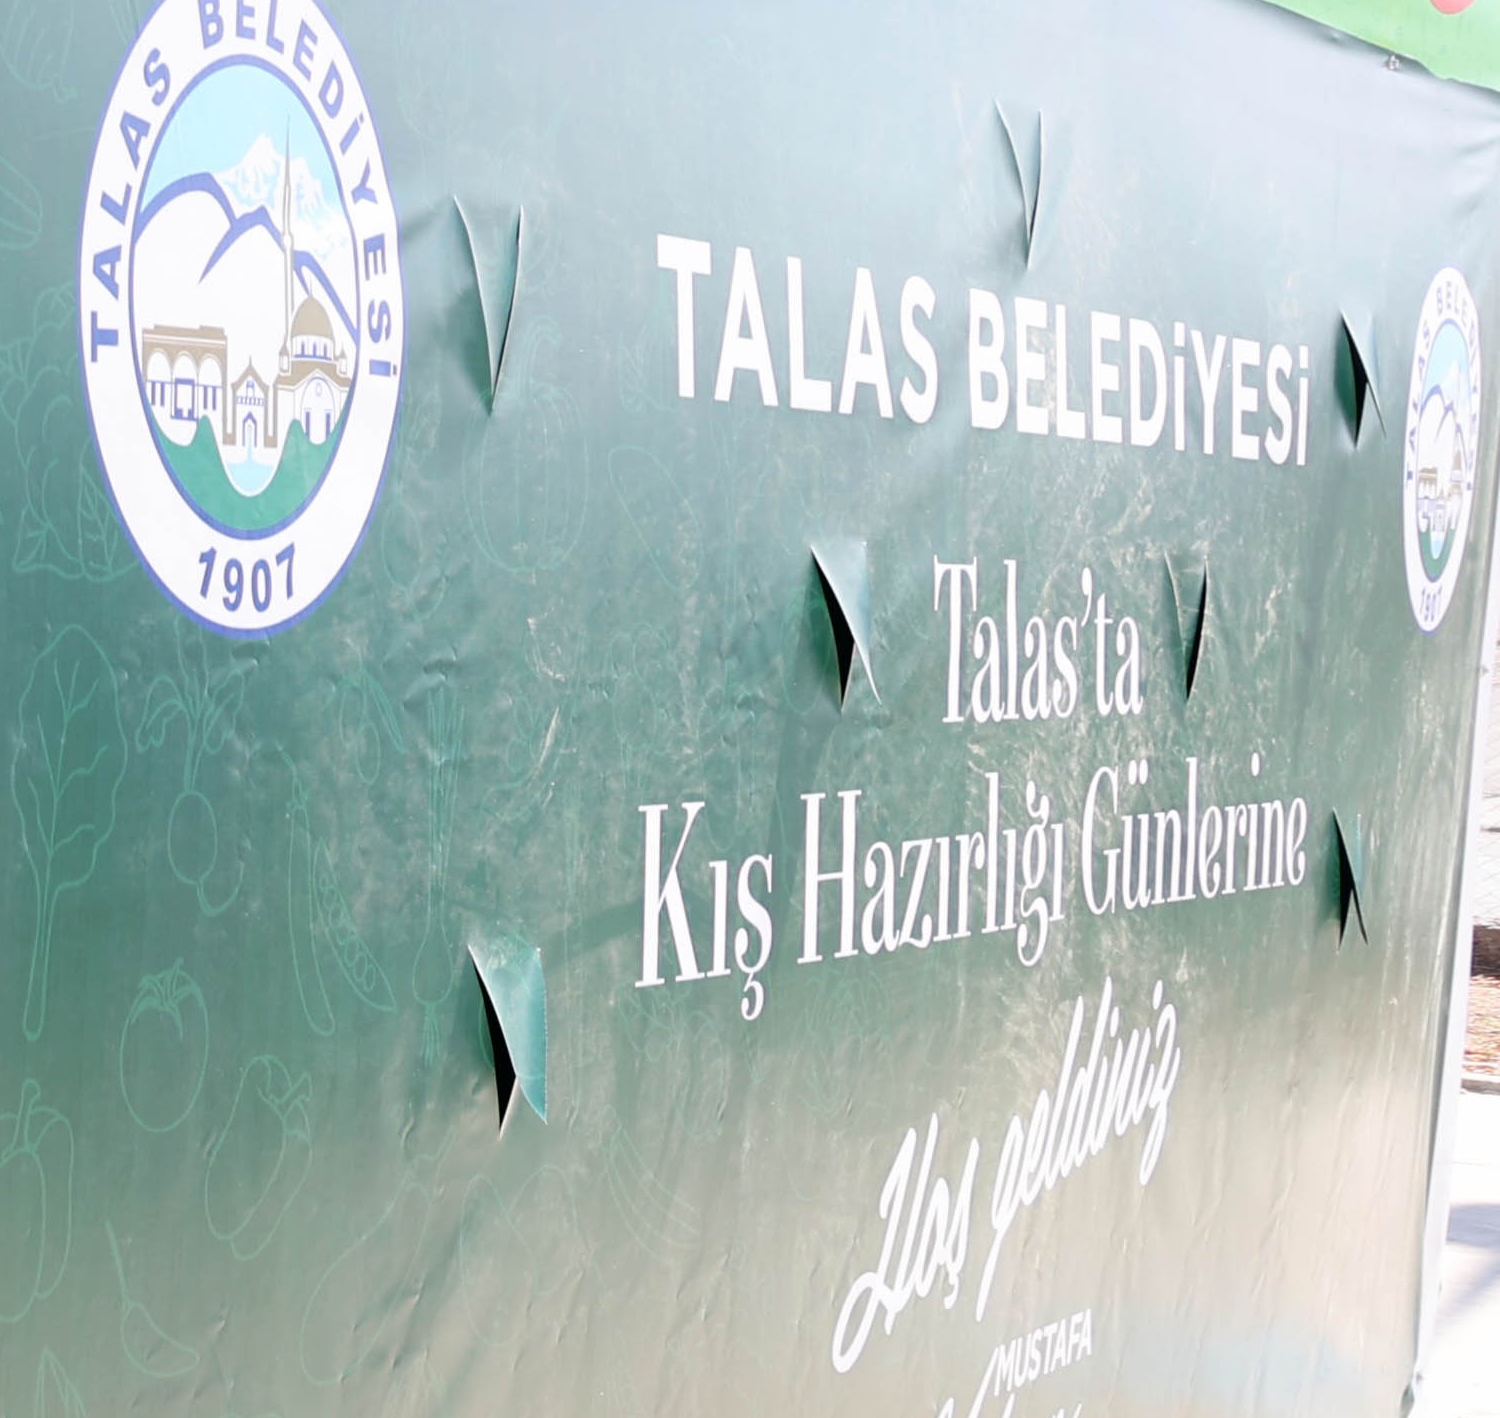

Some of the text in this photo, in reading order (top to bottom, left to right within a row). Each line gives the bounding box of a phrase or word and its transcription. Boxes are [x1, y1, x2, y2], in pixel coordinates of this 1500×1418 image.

[90, 0, 398, 379] TALAS BELEDİYESİ
[655, 233, 1311, 467] TALAS BELEDİYESİ
[198, 544, 297, 613] 1907
[932, 553, 1145, 725] Talas'ta
[634, 752, 1307, 1022] Kış Hazırlığı Günlerine
[831, 975, 1182, 1374] Hoş geldiniz
[994, 1308, 1093, 1397] MUSTAFA
